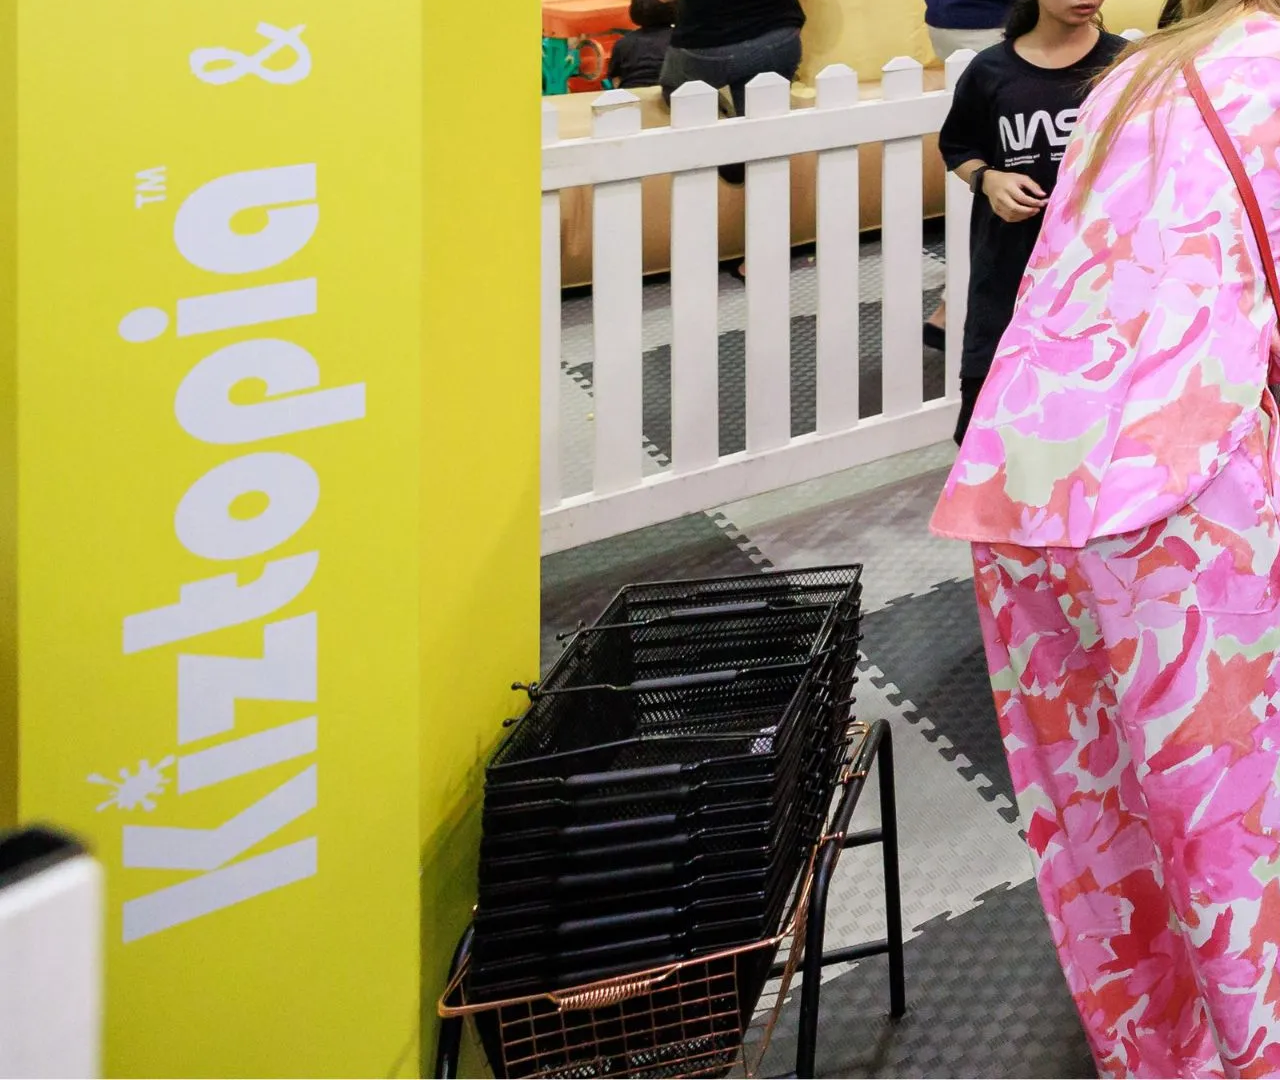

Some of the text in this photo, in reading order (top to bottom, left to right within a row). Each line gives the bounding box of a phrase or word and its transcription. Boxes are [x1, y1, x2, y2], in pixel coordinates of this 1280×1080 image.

[190, 20, 316, 85] &
[135, 166, 166, 208] TM
[90, 162, 366, 942] Kiztopia
